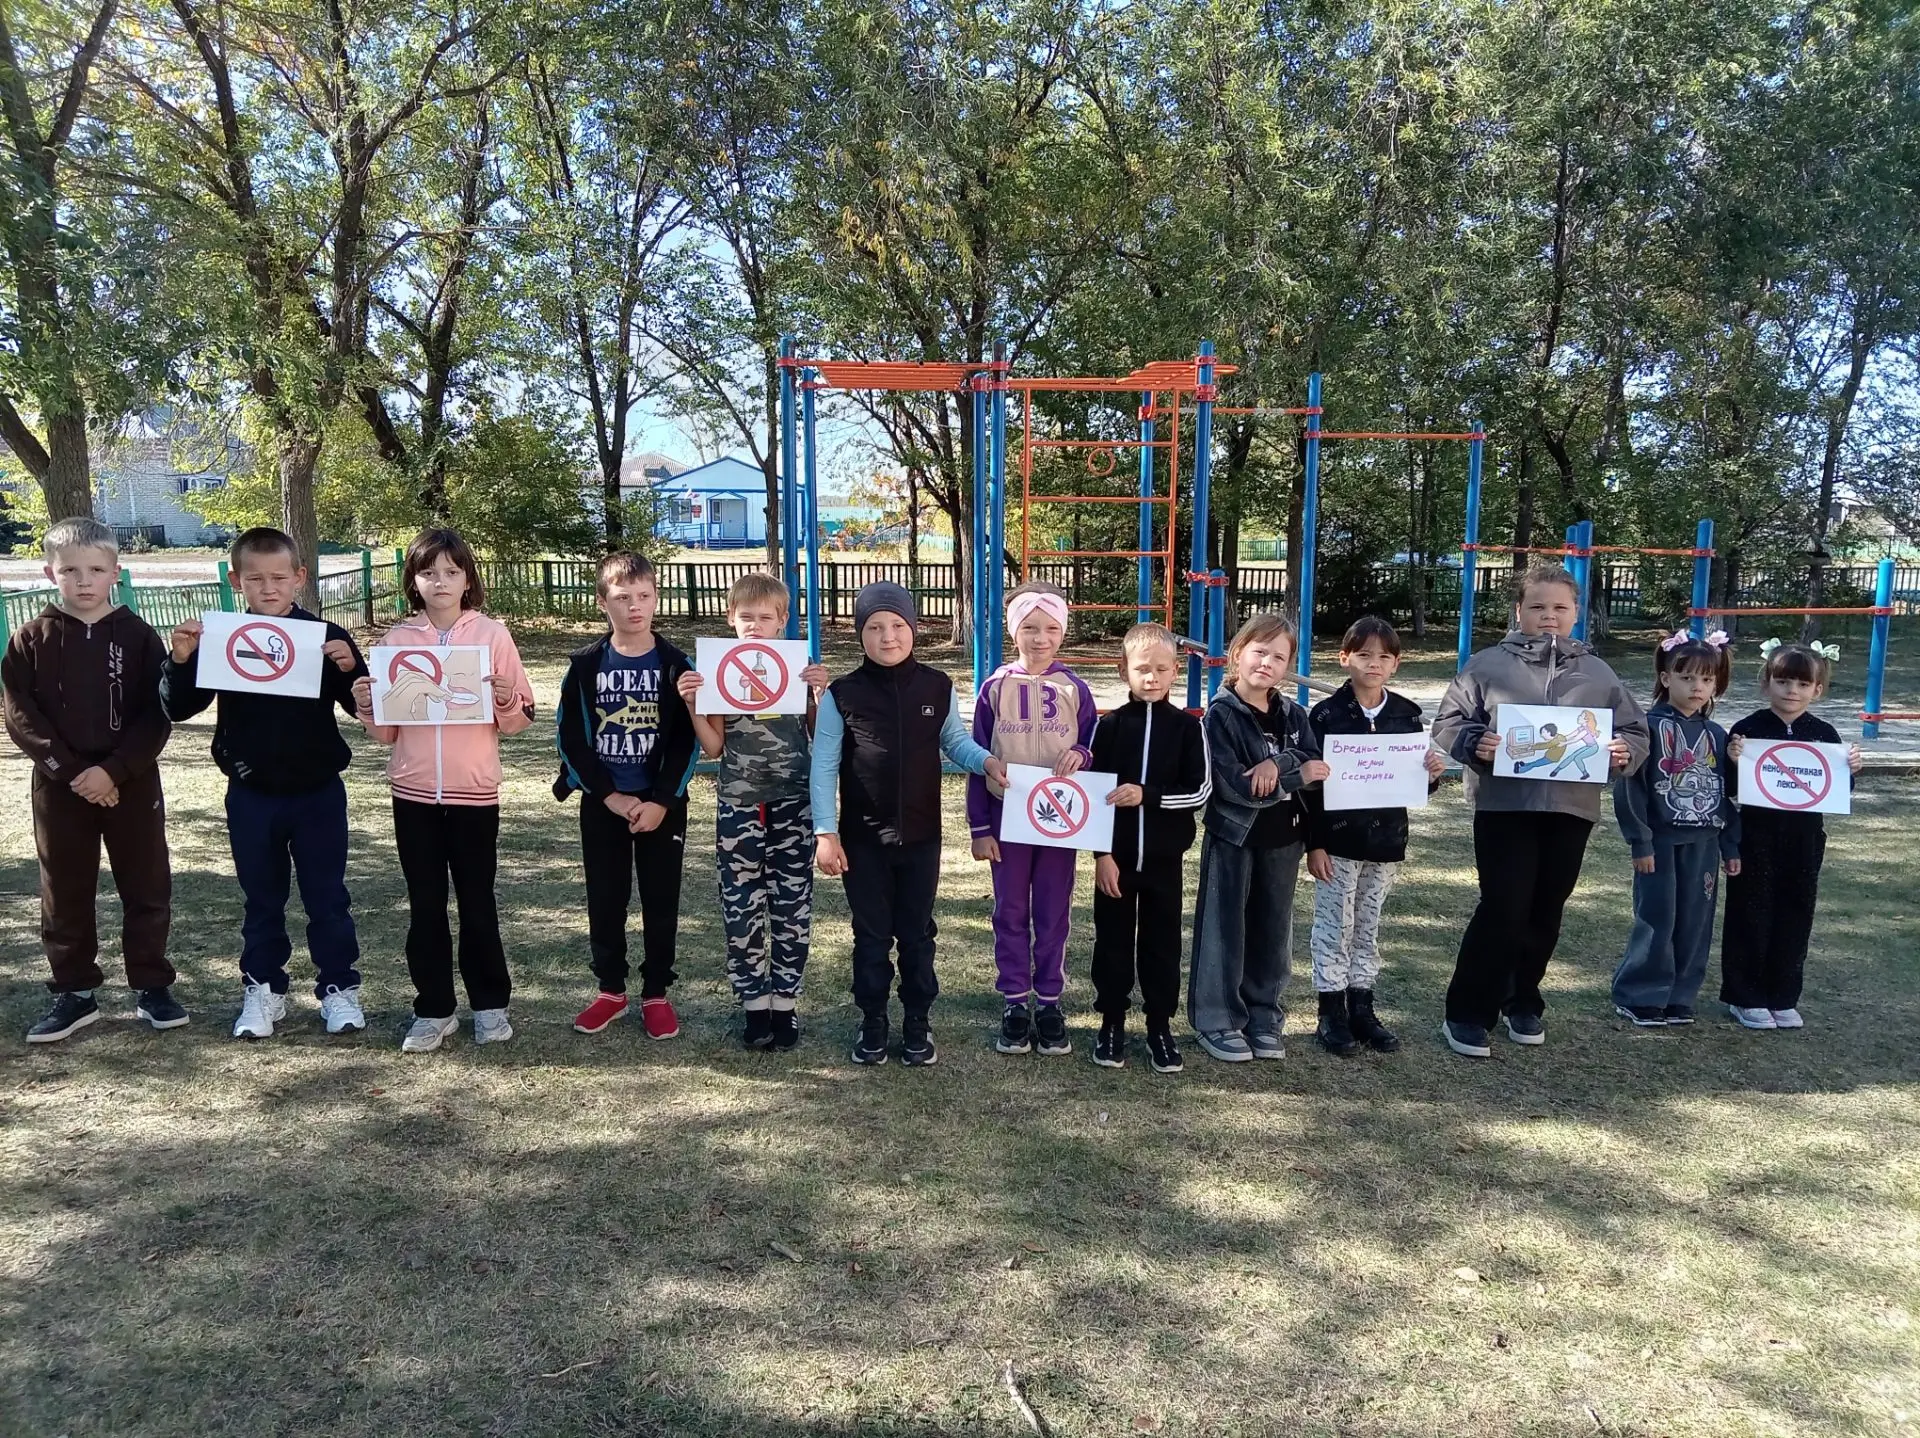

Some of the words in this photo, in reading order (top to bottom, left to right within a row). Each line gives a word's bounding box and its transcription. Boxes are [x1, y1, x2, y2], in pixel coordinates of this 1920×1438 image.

[1018, 683, 1059, 721] 13
[628, 705, 660, 714] WHIT
[596, 733, 660, 756] MIAM
[1332, 740, 1380, 754] Вредные
[1341, 771, 1395, 783] Сестрички
[1762, 764, 1823, 777] неноативная
